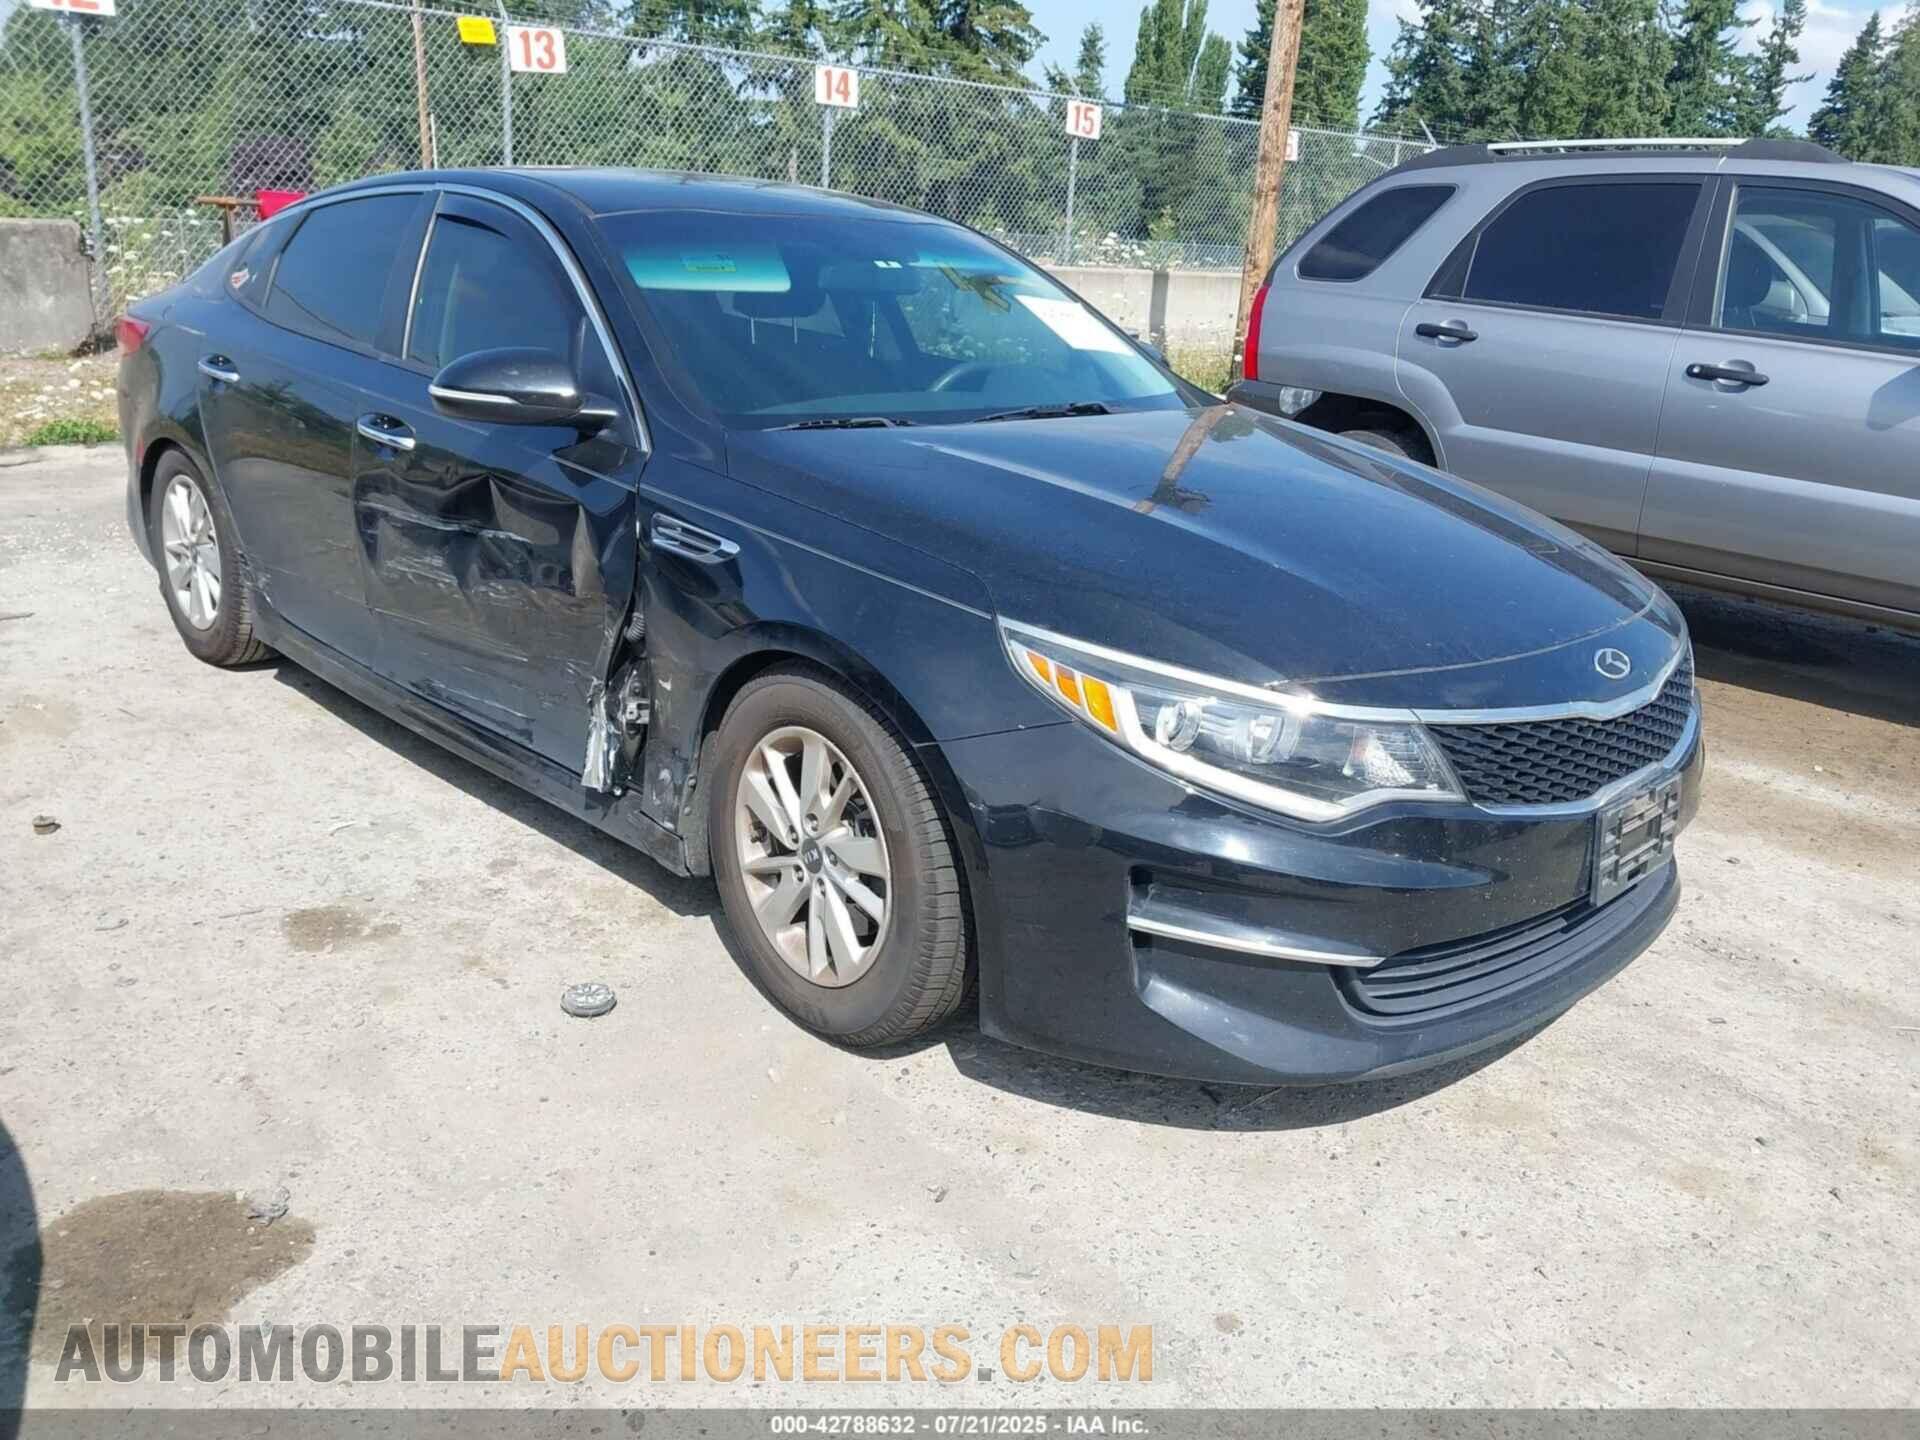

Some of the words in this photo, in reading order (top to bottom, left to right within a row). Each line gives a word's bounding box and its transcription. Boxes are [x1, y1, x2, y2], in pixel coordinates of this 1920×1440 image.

[519, 29, 556, 69] 13
[824, 69, 851, 103] 14
[1074, 104, 1095, 135] 15
